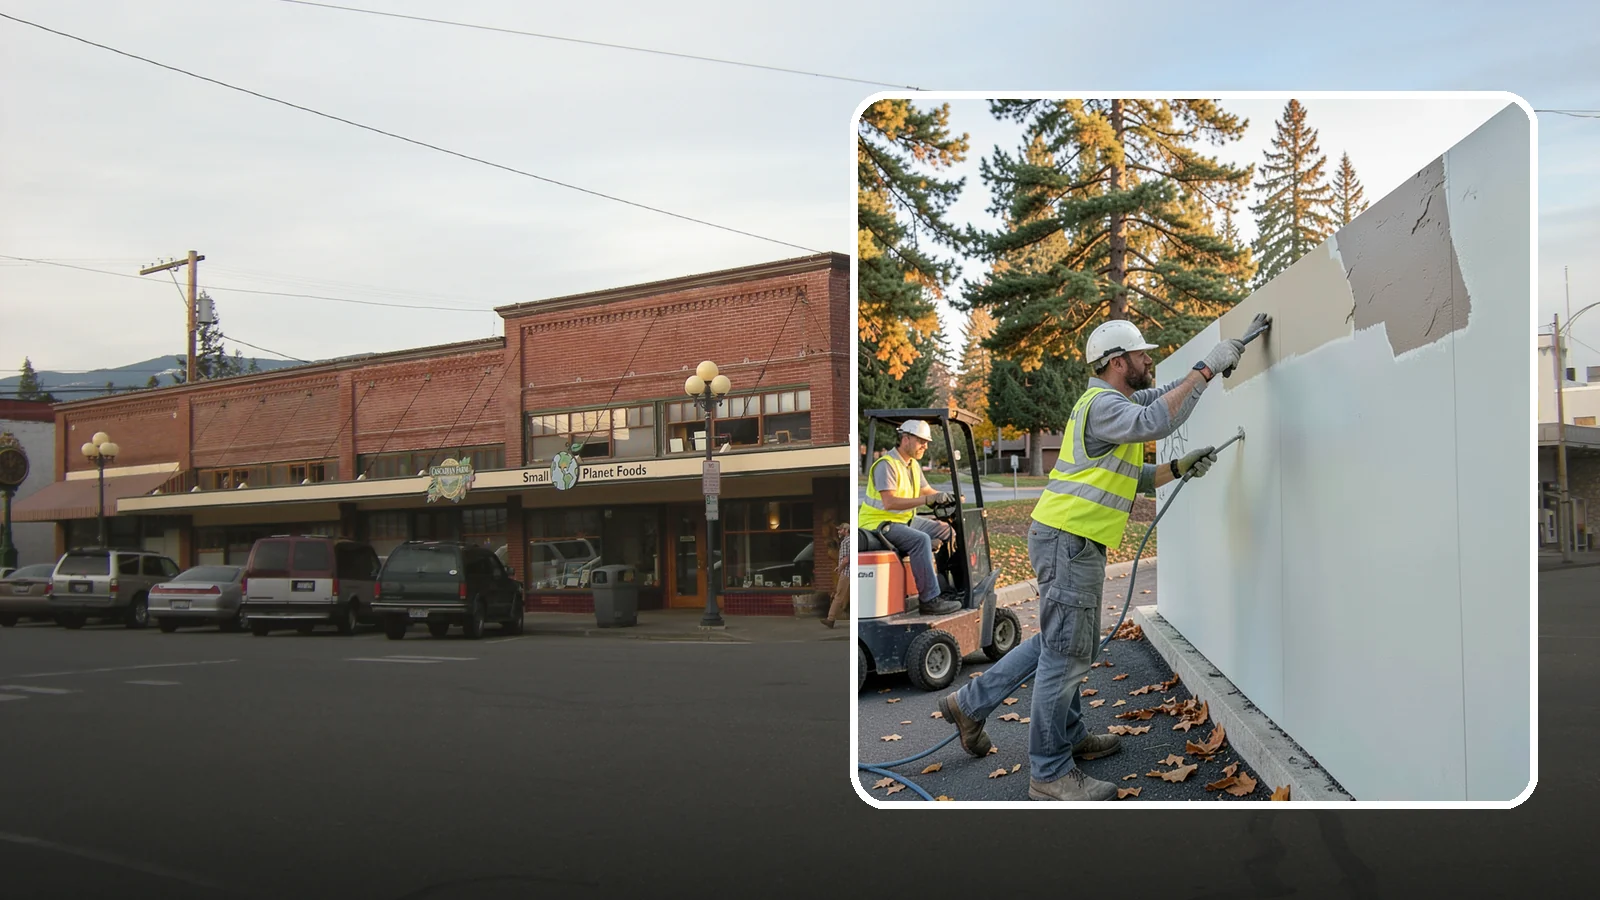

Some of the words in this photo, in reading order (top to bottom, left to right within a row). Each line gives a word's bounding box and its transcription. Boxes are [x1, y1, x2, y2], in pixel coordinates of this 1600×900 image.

[523, 471, 549, 482] Small
[583, 467, 614, 479] Planet
[617, 465, 647, 477] Foods
